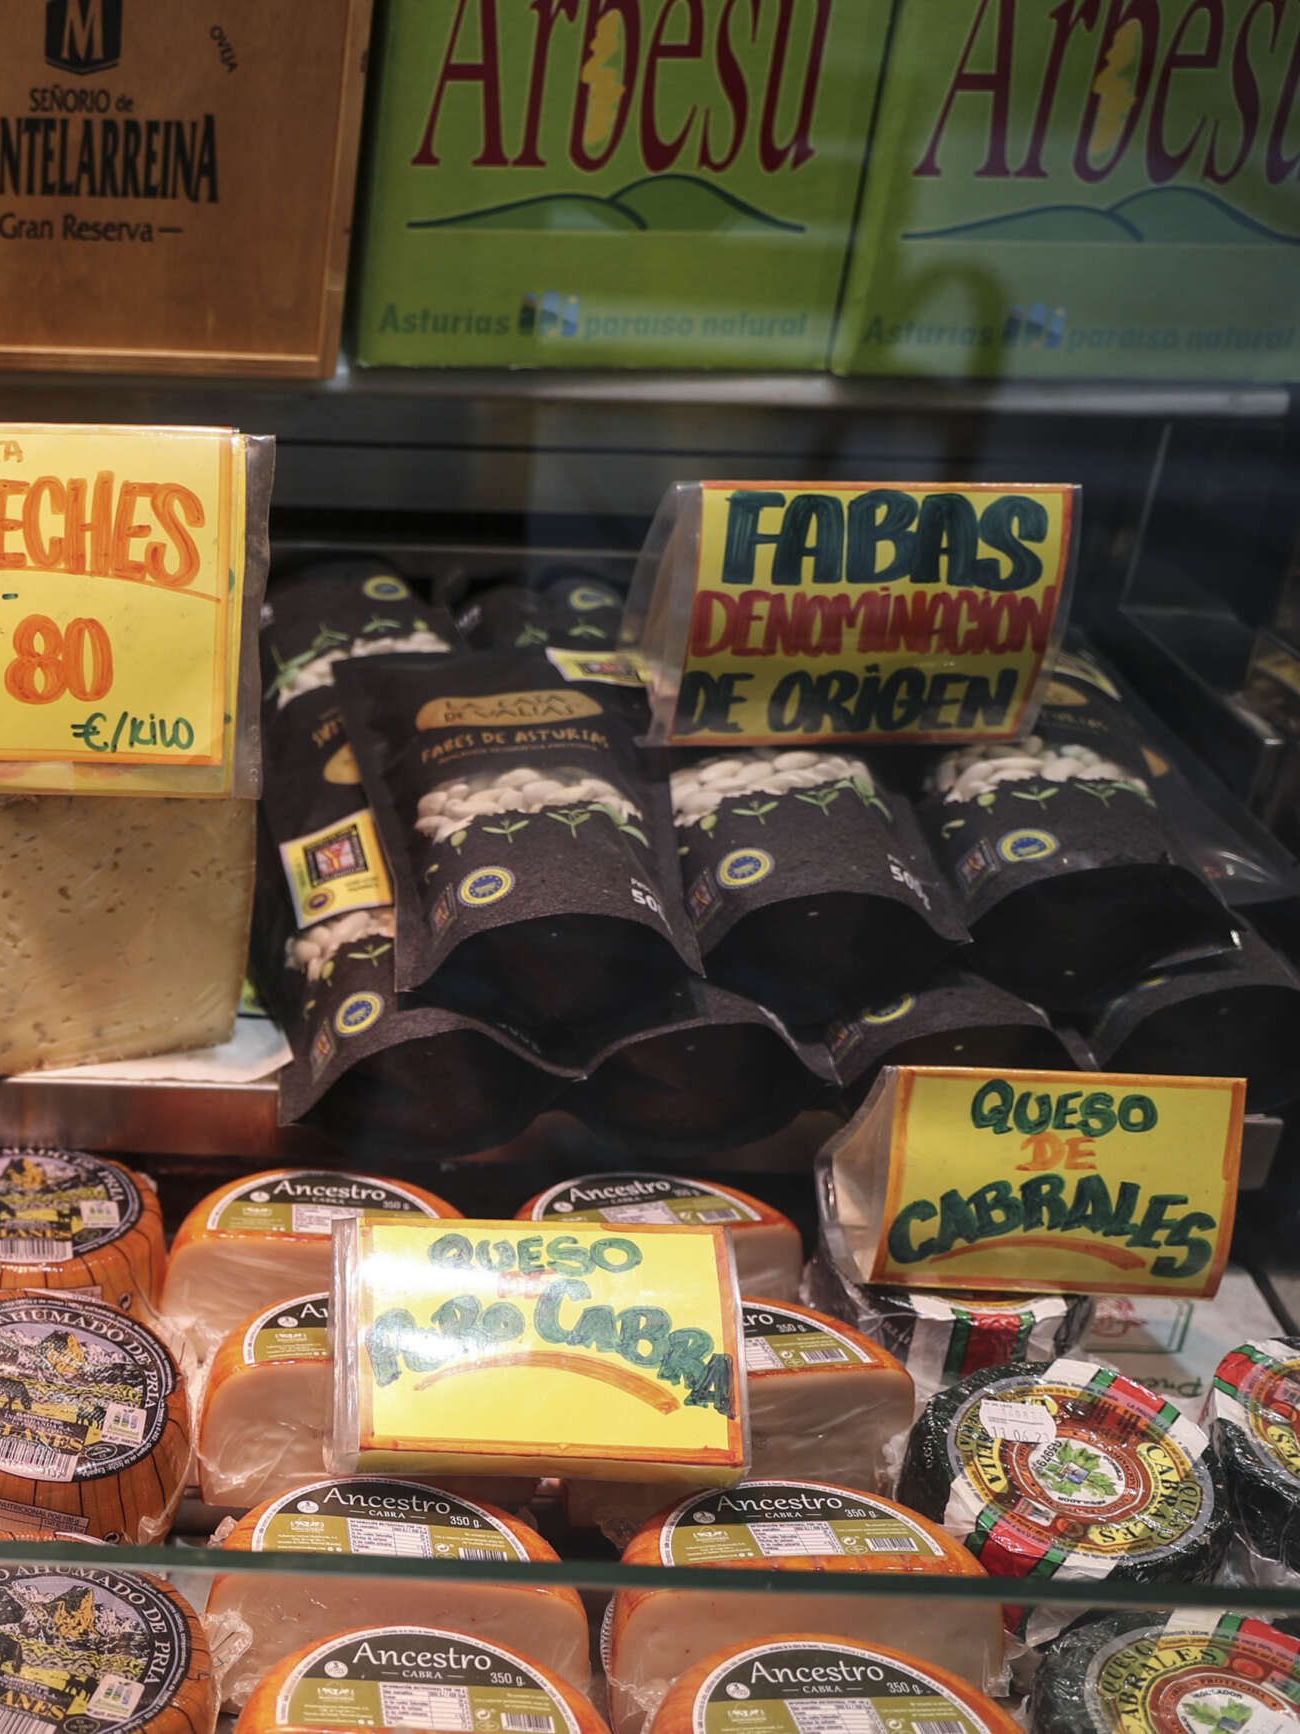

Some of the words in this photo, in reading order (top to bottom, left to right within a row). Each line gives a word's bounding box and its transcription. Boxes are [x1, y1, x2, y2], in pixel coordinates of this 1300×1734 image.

[209, 26, 239, 74] OVEJA
[115, 94, 133, 113] de
[62, 214, 154, 243] Reserva
[379, 305, 511, 337] Asturias
[701, 309, 807, 338] natural
[721, 489, 1049, 591] FABAS
[674, 670, 755, 736] DE
[481, 731, 506, 744] DE
[970, 1078, 1159, 1137] QUESO
[1015, 1131, 1098, 1171] DE
[273, 1179, 386, 1201] Ancestro
[569, 1178, 671, 1203] Ancestro
[888, 1173, 1217, 1278] CABRALES
[427, 1232, 643, 1277] QUESO
[534, 1279, 737, 1420] CABRA
[125, 1336, 151, 1366] DE
[144, 1370, 160, 1409] PRIA
[323, 1486, 451, 1515] Ancestro
[368, 1509, 406, 1519] CABRA
[717, 1494, 843, 1513] Ancestro
[764, 1511, 803, 1519] CABRA
[844, 1508, 866, 1518] 350
[450, 1515, 470, 1527] 350
[16, 1565, 146, 1606] AHUMADO
[144, 1606, 167, 1634] DE
[144, 1641, 171, 1684] PRIA
[351, 1642, 491, 1671] Ancestro
[1102, 1640, 1157, 1694] QUESO
[402, 1669, 443, 1680] CABRA
[490, 1672, 512, 1684] 350
[750, 1660, 884, 1684] Ancestro
[802, 1685, 843, 1694] CABRA
[886, 1682, 910, 1694] 350
